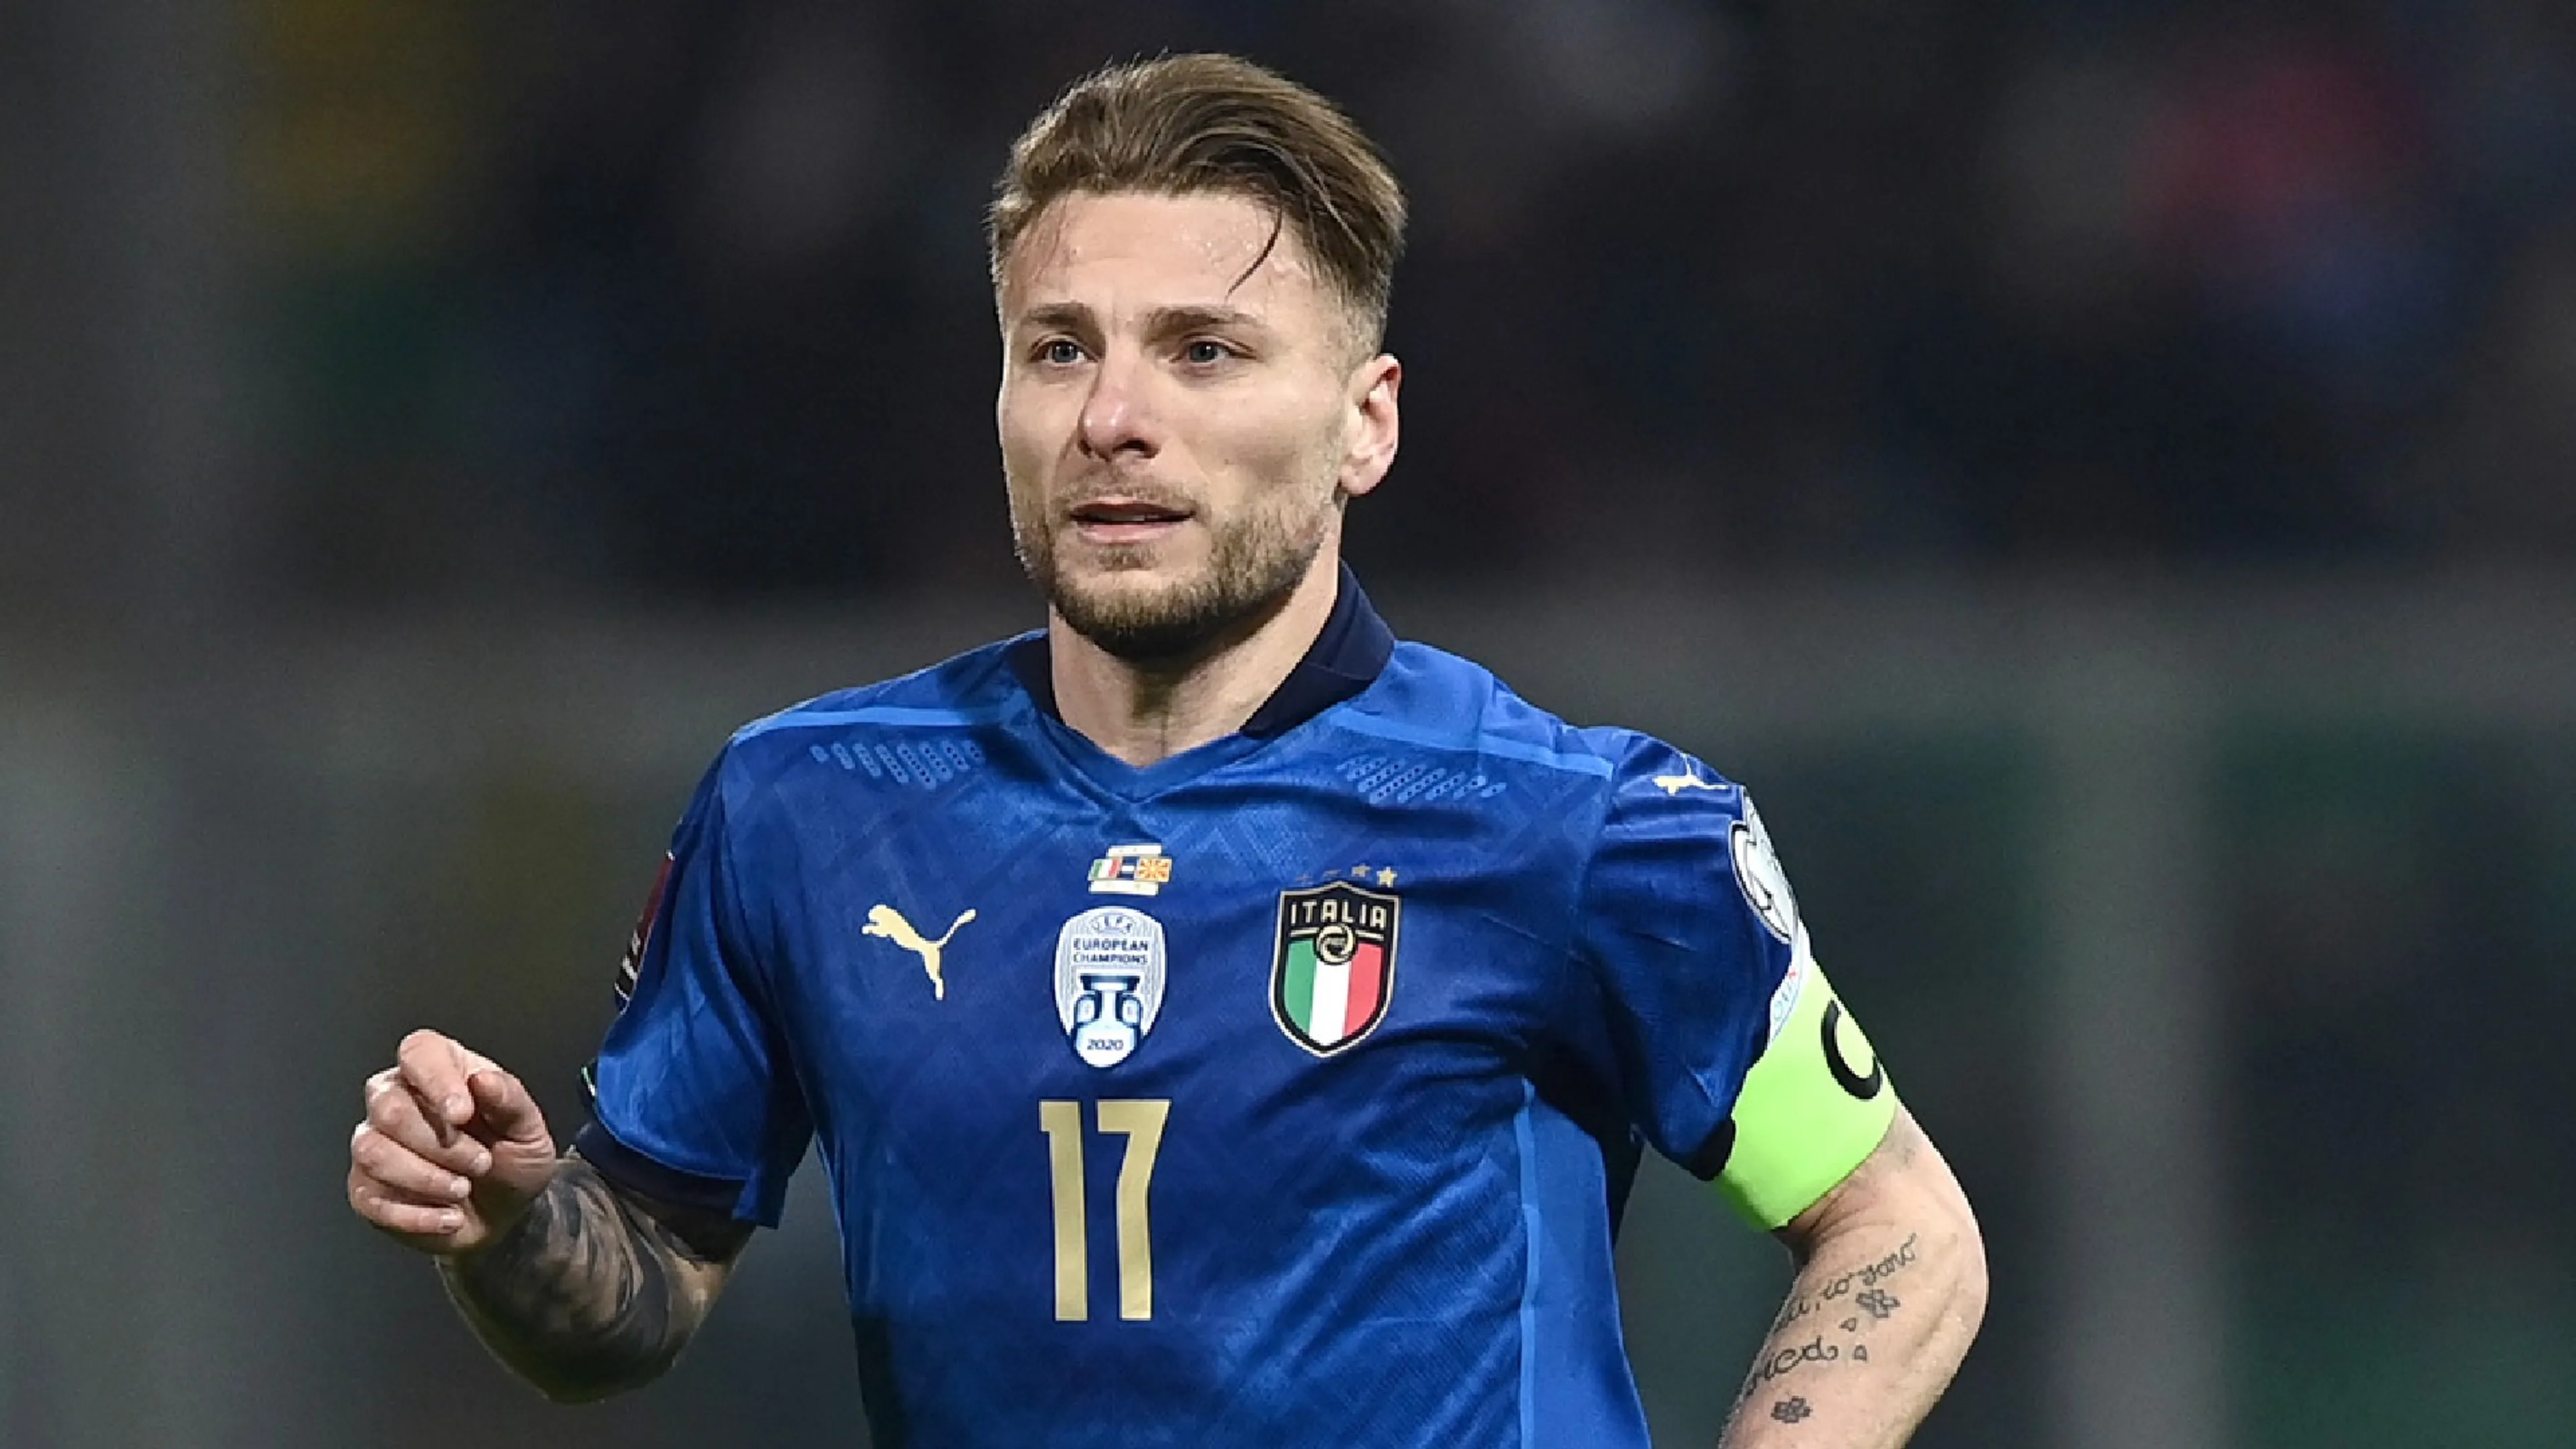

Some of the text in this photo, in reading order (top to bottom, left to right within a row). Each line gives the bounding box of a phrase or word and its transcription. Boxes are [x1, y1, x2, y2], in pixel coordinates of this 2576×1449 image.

[1290, 899, 1387, 929] ITALIA
[1073, 938, 1148, 951] EUROPEAN
[1073, 952, 1148, 965] CHAMPIONS
[1087, 1038, 1124, 1051] 2020
[1821, 999, 1880, 1099] C
[1039, 1099, 1171, 1321] 17
